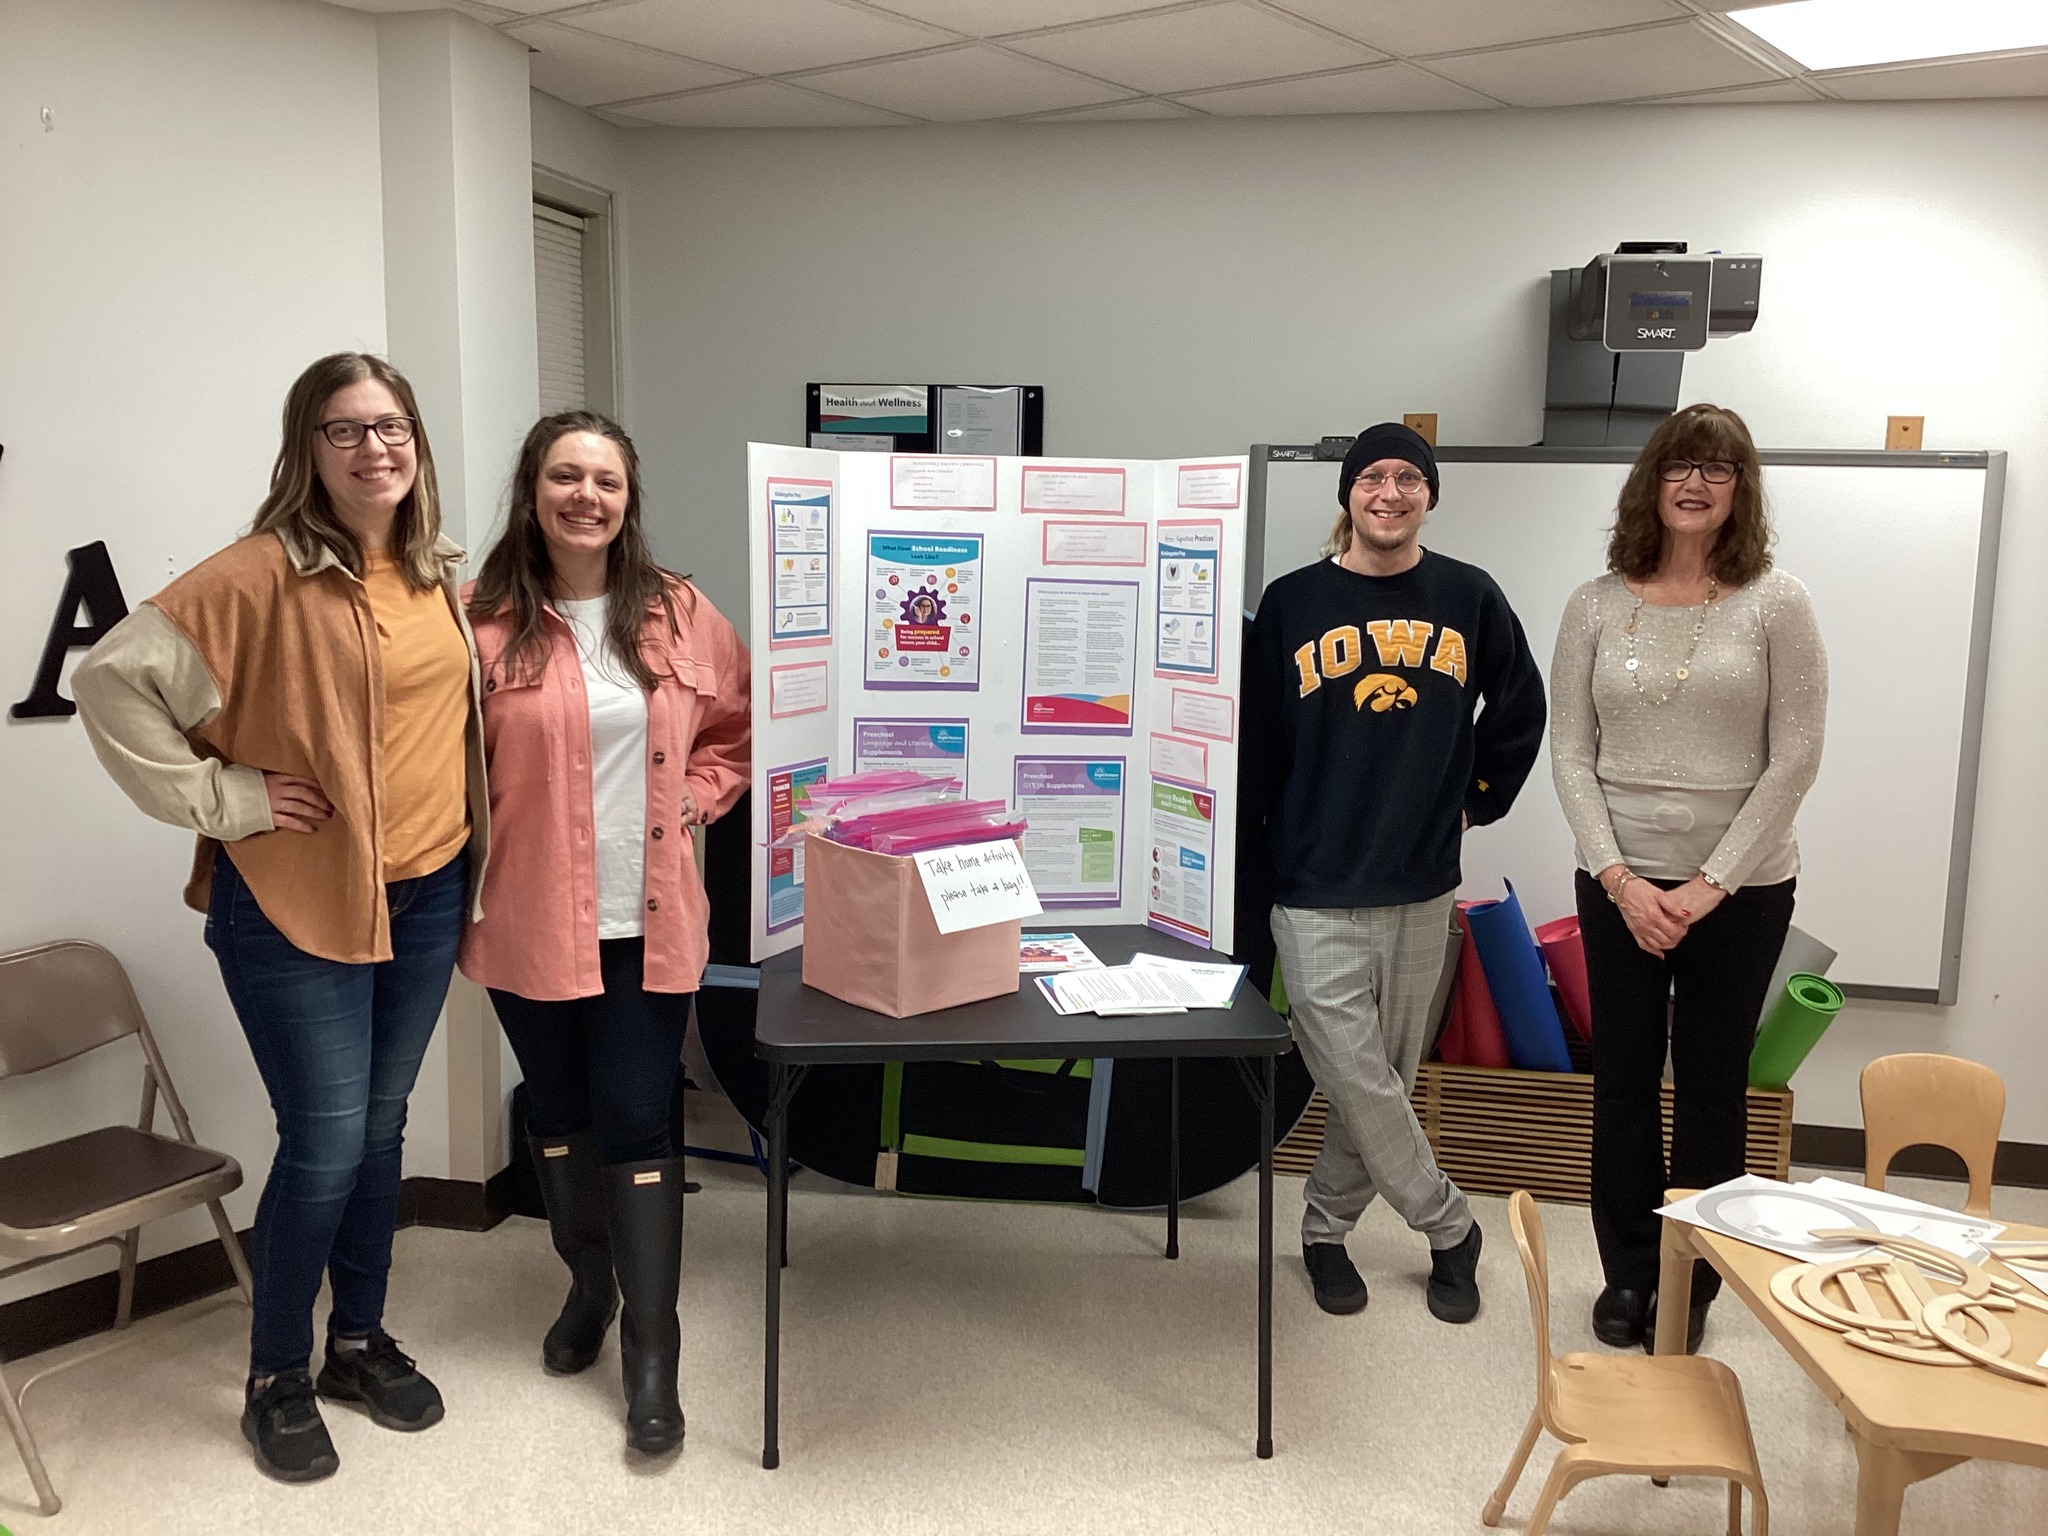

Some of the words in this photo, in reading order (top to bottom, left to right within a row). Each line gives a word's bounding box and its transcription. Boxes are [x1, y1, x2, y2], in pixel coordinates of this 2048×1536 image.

[1637, 328, 1676, 339] SMART
[826, 397, 858, 407] Health
[878, 398, 922, 408] Wellness
[11, 540, 129, 718] A
[1294, 619, 1467, 698] IOWA
[924, 857, 954, 876] Take
[955, 854, 981, 870] home
[984, 846, 1016, 865] activity
[940, 889, 967, 911] please
[970, 882, 989, 897] take
[992, 882, 999, 891] a
[1000, 874, 1028, 896] bag!!
